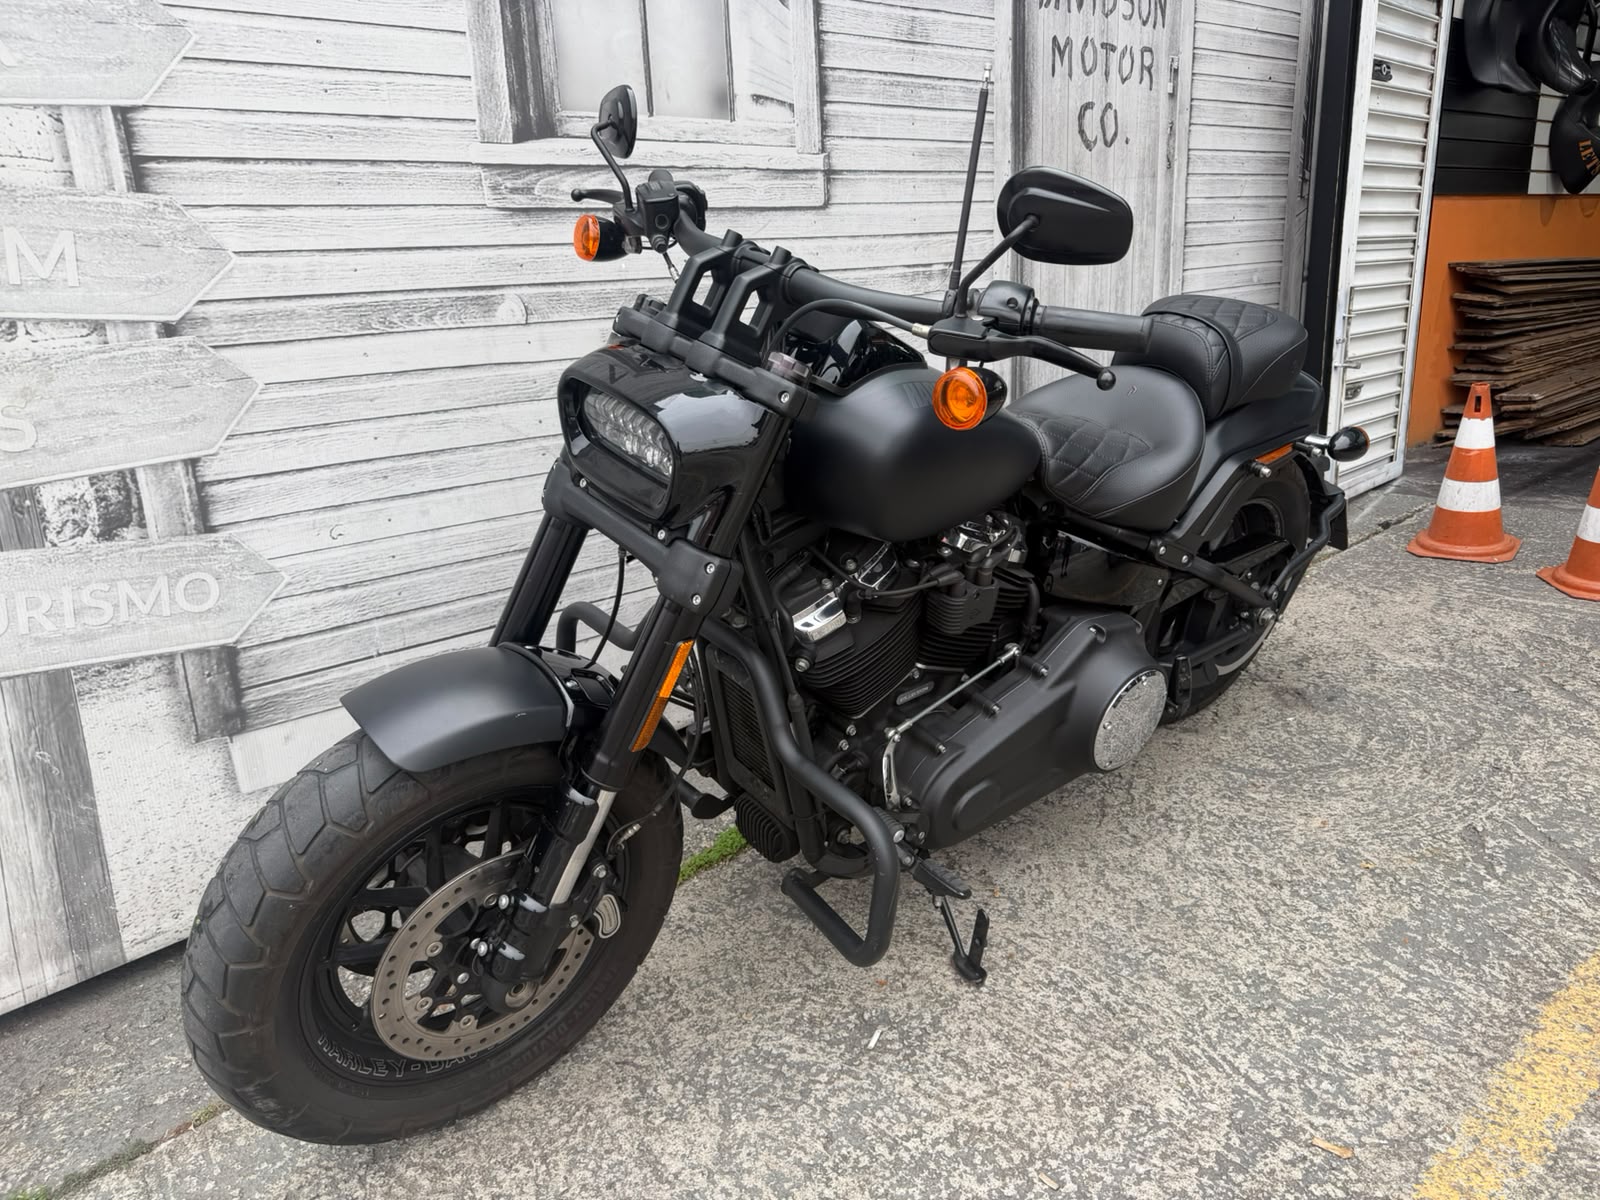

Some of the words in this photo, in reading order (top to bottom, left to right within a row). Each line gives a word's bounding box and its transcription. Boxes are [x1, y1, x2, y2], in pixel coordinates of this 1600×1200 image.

[1051, 34, 1156, 91] MOTOR
[1077, 101, 1131, 152] CO.
[0, 571, 221, 637] RISMO
